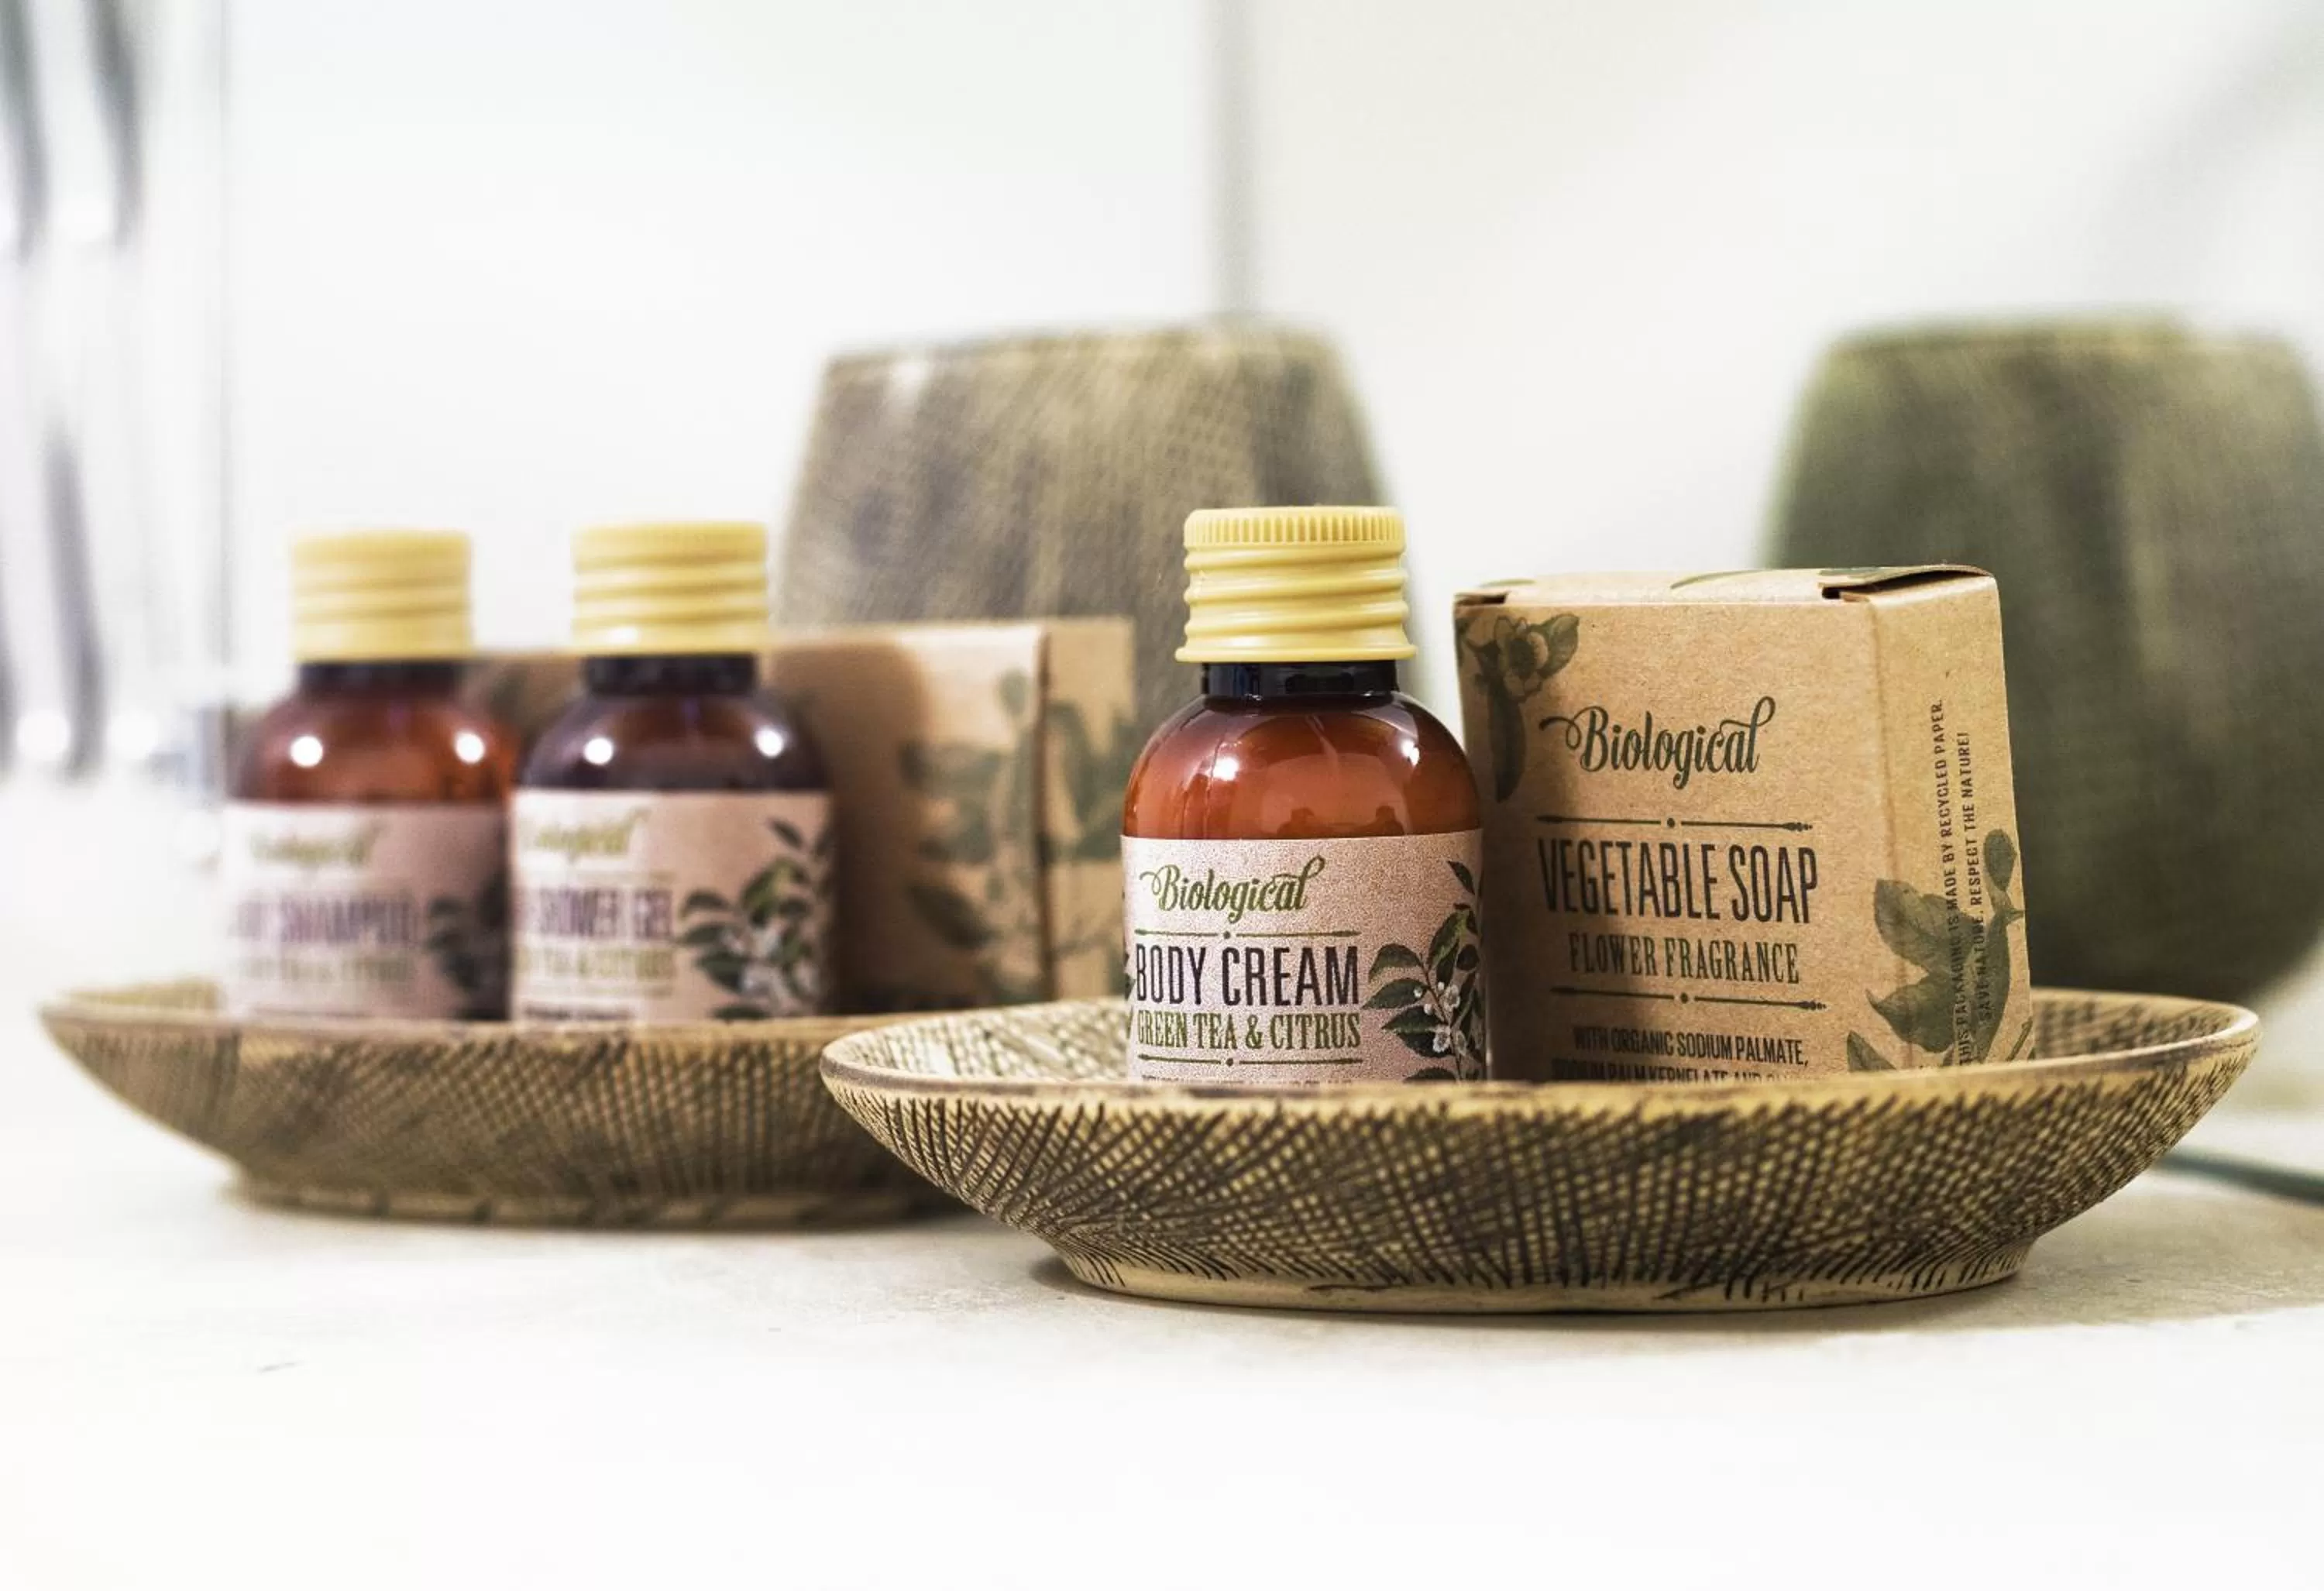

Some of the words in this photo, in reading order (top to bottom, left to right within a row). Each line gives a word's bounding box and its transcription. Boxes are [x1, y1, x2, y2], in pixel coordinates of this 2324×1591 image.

[1539, 696, 1776, 789] Biological
[1930, 699, 1946, 754] PAPER.
[1956, 731, 1975, 799] NATURE!
[1935, 758, 1953, 838] RECYCLED
[1961, 802, 1978, 833] THE
[1538, 838, 1721, 920] VEGETABLE
[1729, 845, 1817, 923] SOAP
[1941, 844, 1954, 864] BY
[1965, 838, 1983, 906] RESPECT
[1140, 856, 1325, 924] Biological
[1944, 866, 1958, 911] MADE
[1947, 915, 1959, 932] IS
[1136, 944, 1207, 1006] BODY
[1221, 944, 1360, 1007] CREAM
[1569, 932, 1659, 977] FLOWER
[1664, 936, 1800, 984] FRAGRANCE
[1137, 1012, 1188, 1048] GREEN
[1192, 1013, 1238, 1050] TEA
[1245, 1014, 1263, 1050] &
[1270, 1012, 1361, 1050] CITRUS
[1611, 1027, 1674, 1057] ORGANIC
[1676, 1032, 1733, 1060] SODIUM
[1735, 1036, 1810, 1067] PALMATE,
[1958, 1026, 1974, 1066] THIS
